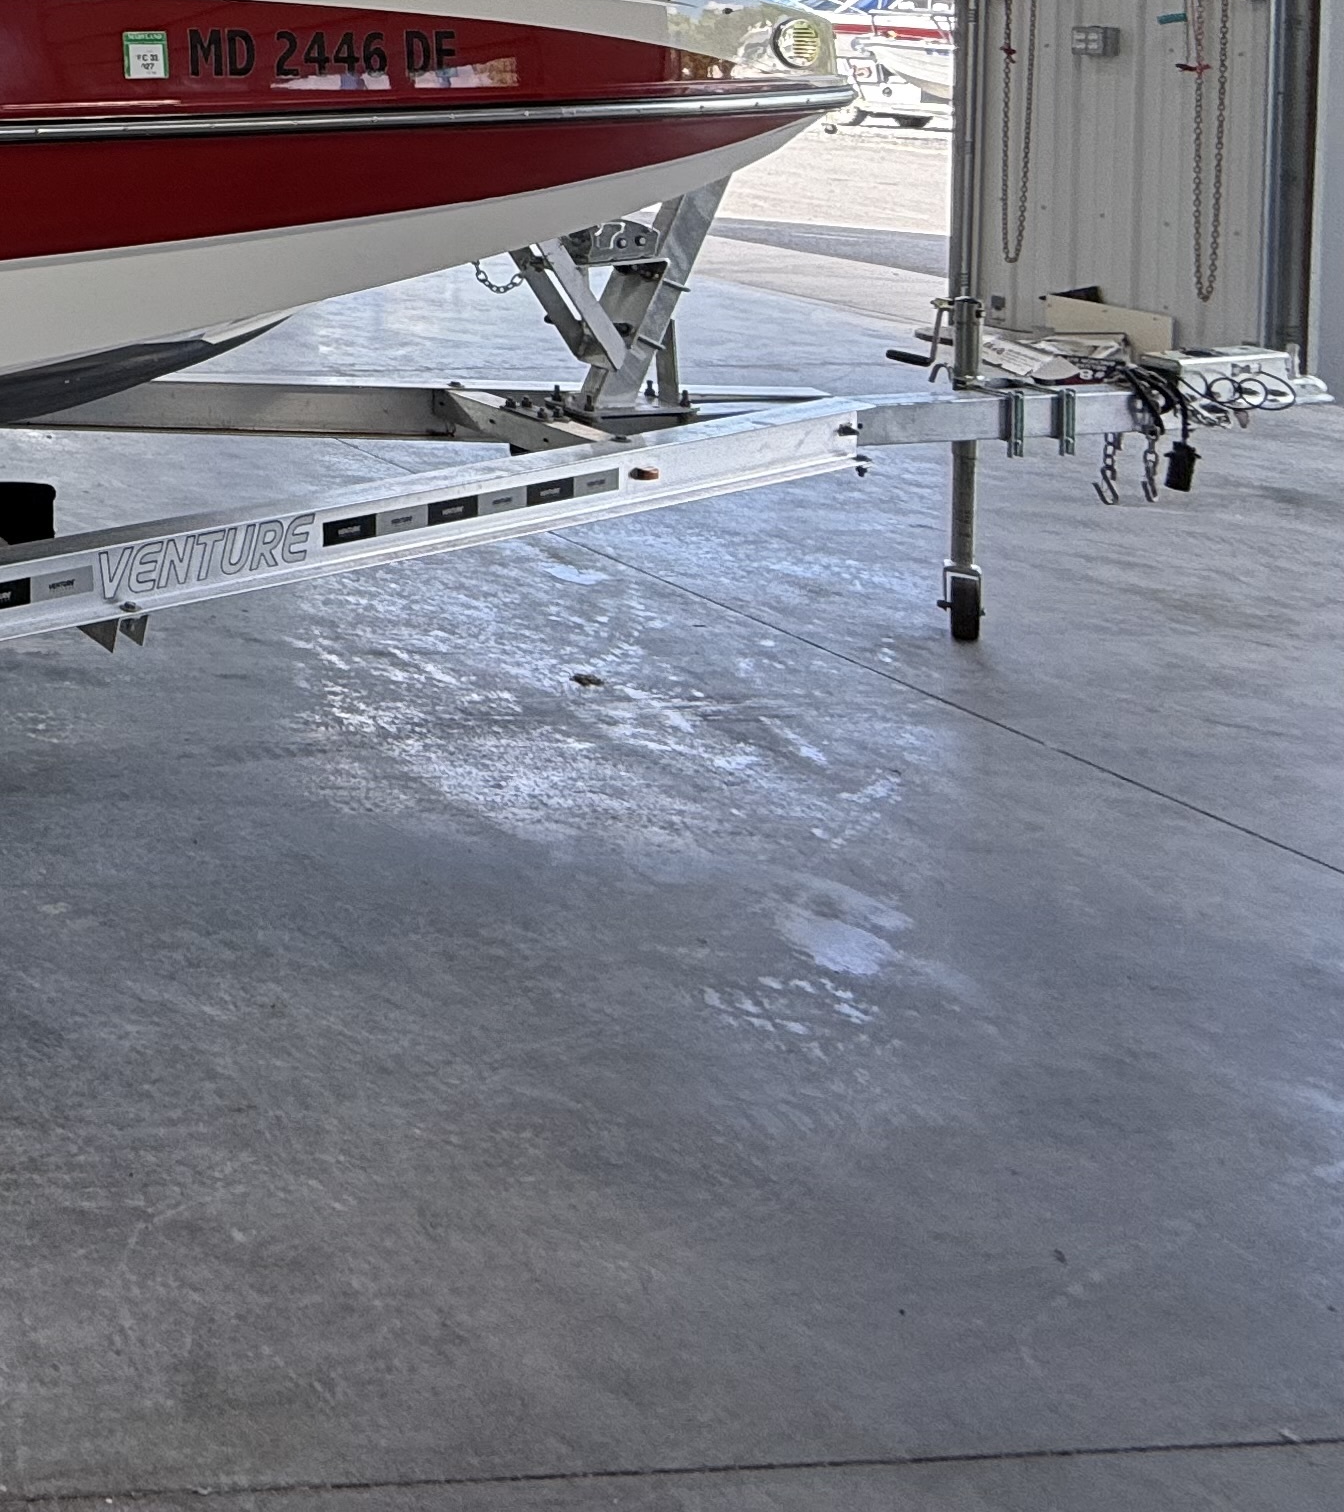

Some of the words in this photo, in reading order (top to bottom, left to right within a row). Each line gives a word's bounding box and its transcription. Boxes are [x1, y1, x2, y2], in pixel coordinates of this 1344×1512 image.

[188, 28, 256, 78] MD
[275, 30, 389, 78] 2446
[97, 512, 317, 600] VENTURE
